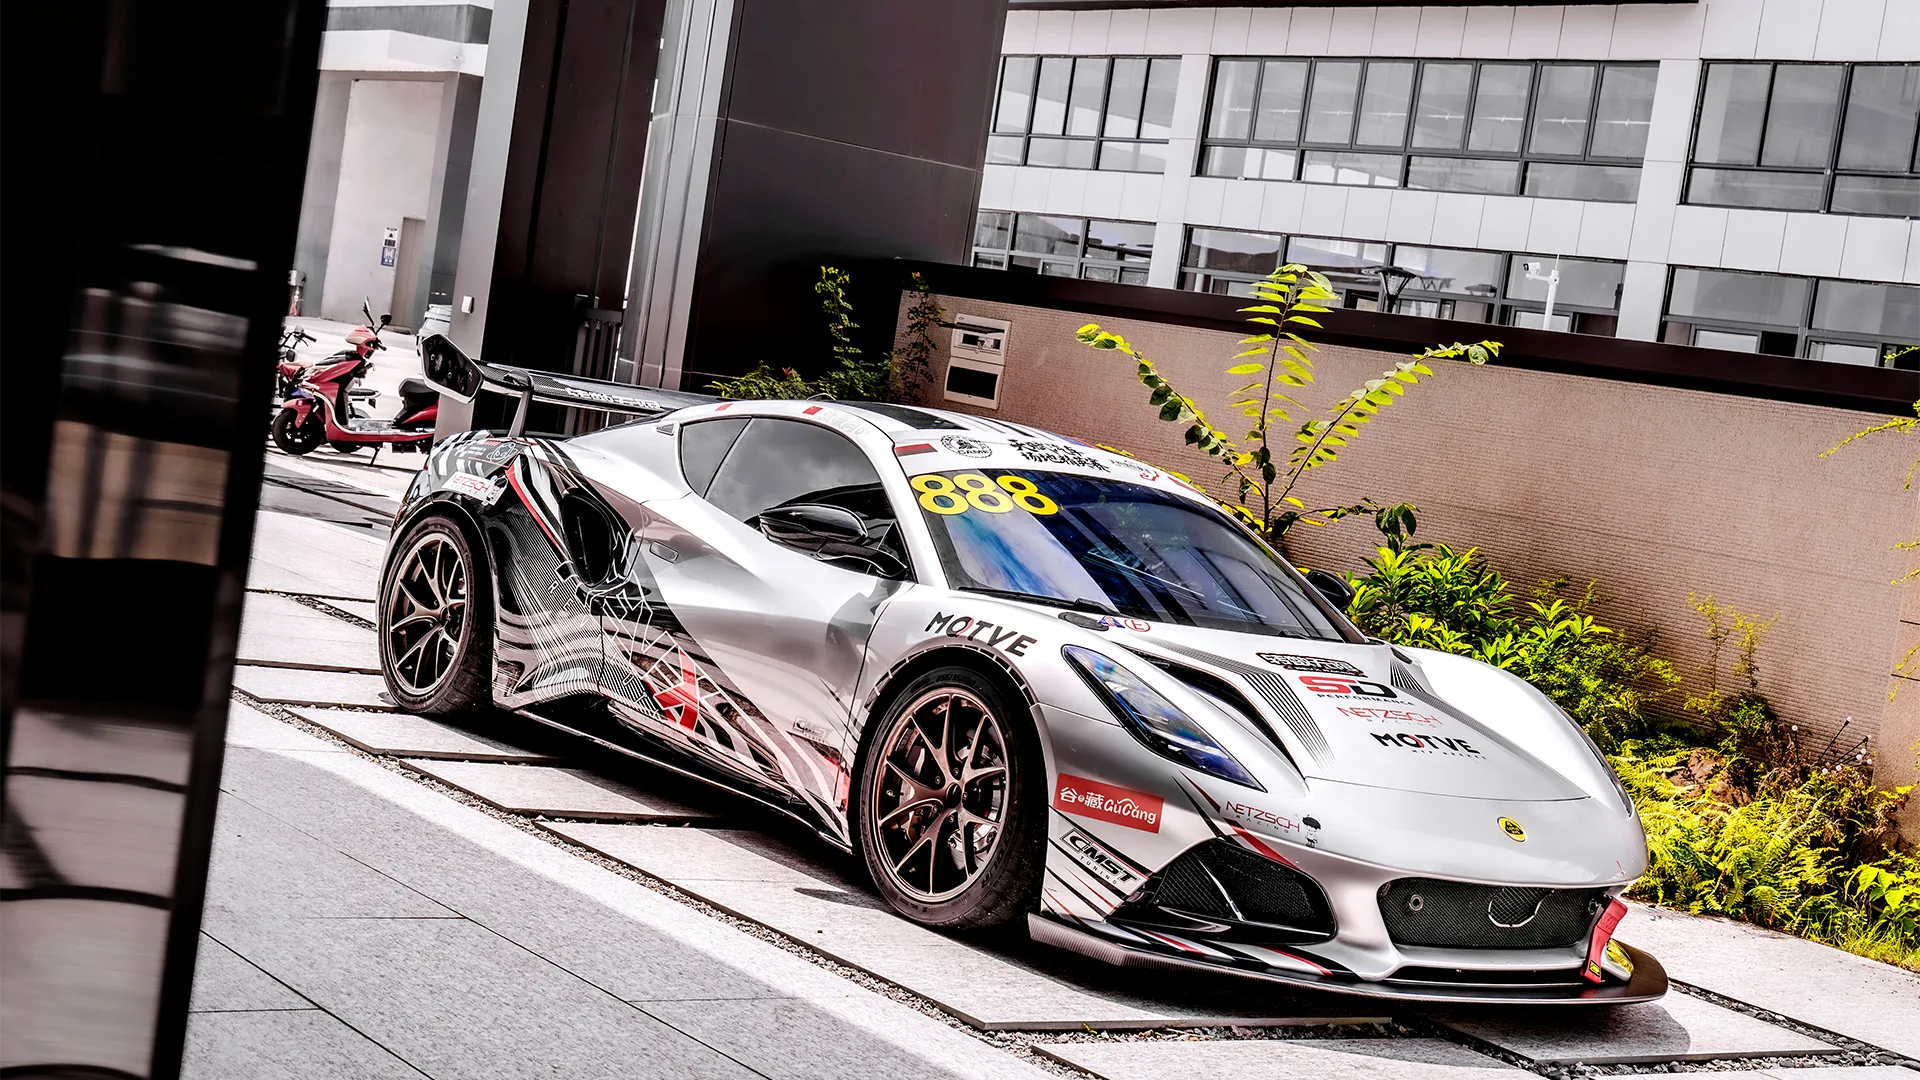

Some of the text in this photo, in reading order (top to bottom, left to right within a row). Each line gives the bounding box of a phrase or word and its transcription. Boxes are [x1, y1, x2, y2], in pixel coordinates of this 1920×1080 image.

[911, 474, 1059, 516] 888
[924, 611, 1038, 657] MOTVE
[1299, 675, 1398, 699] SD
[1317, 693, 1416, 707] PERFORMANCE
[1336, 706, 1444, 726] NETZSCH
[1370, 732, 1482, 755] MOTVE
[1226, 801, 1300, 832] NETZSCH
[1236, 815, 1289, 834] RACING
[1069, 835, 1138, 882] CMST
[1080, 856, 1118, 884] TUNING
